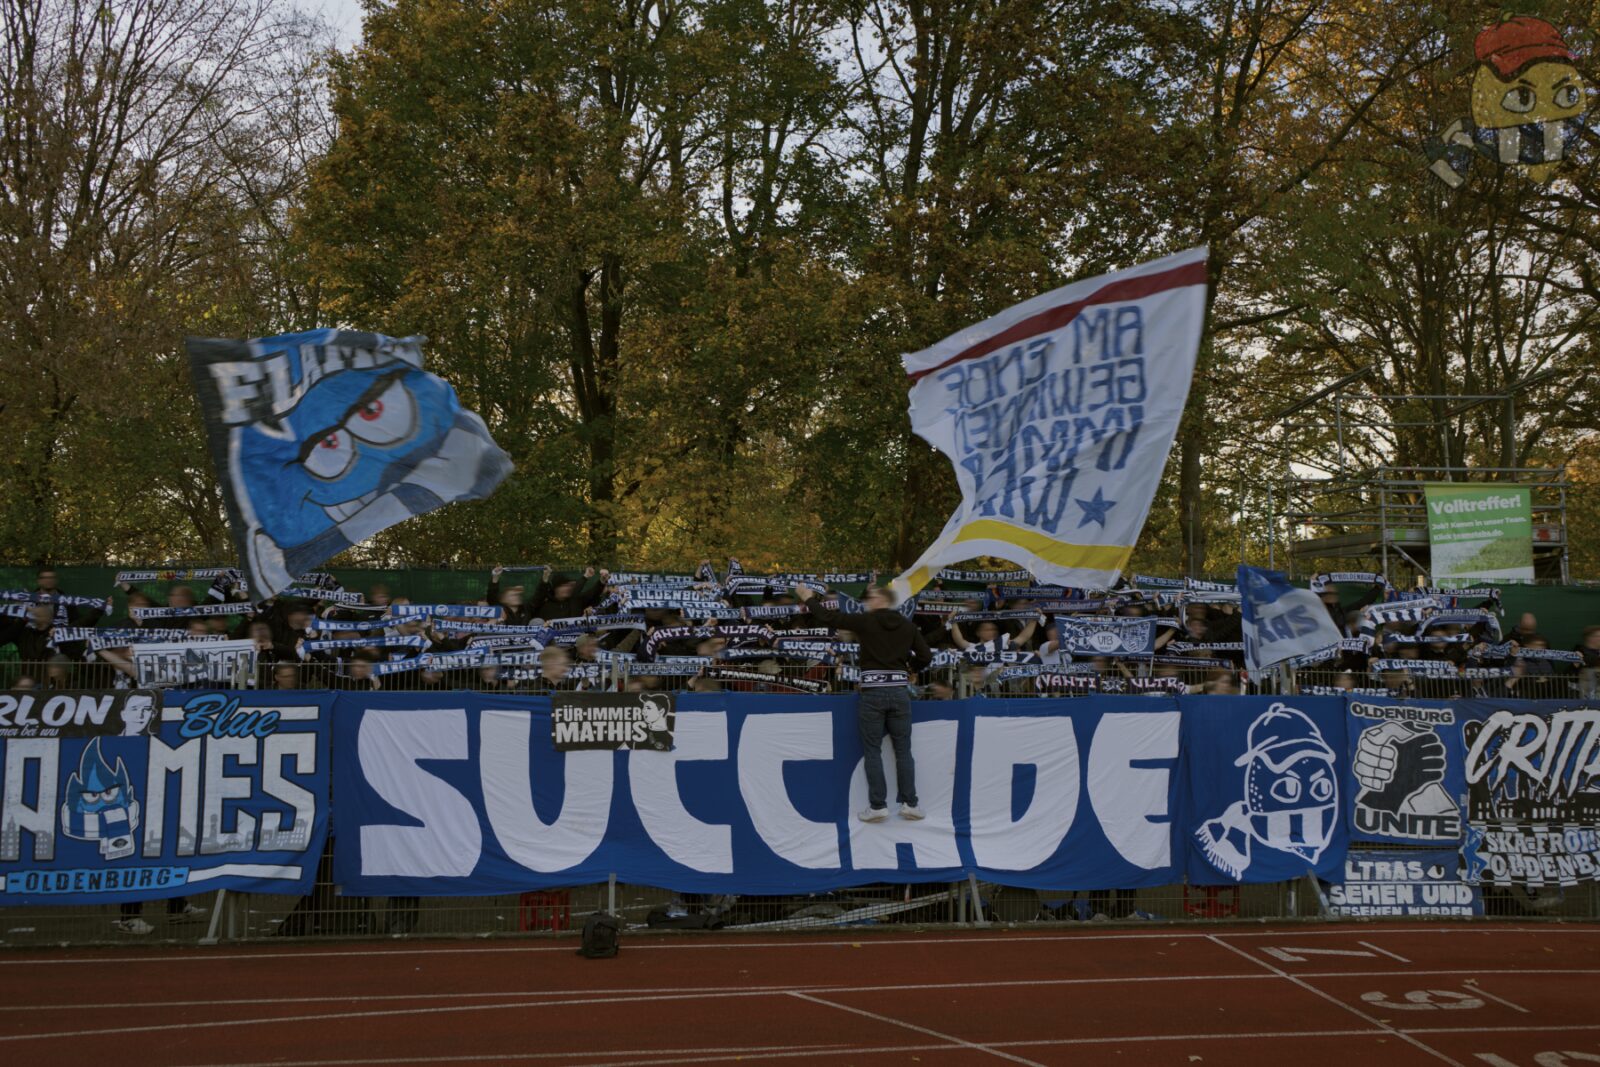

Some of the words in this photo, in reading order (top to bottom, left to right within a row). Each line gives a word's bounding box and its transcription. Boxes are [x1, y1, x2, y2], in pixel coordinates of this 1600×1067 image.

[1430, 494, 1521, 515] Volltreffer!
[0, 694, 115, 727] RLON
[179, 693, 281, 738] Blue
[1351, 703, 1454, 723] OLDENBURG
[555, 721, 648, 744] MATHIS
[358, 709, 1181, 878] SUCCADE
[1356, 807, 1460, 838] UNITE
[1490, 853, 1600, 878] OLDENB
[25, 867, 173, 892] OLDENBURG
[1329, 885, 1414, 905] SEHEN
[1422, 884, 1474, 905] UND
